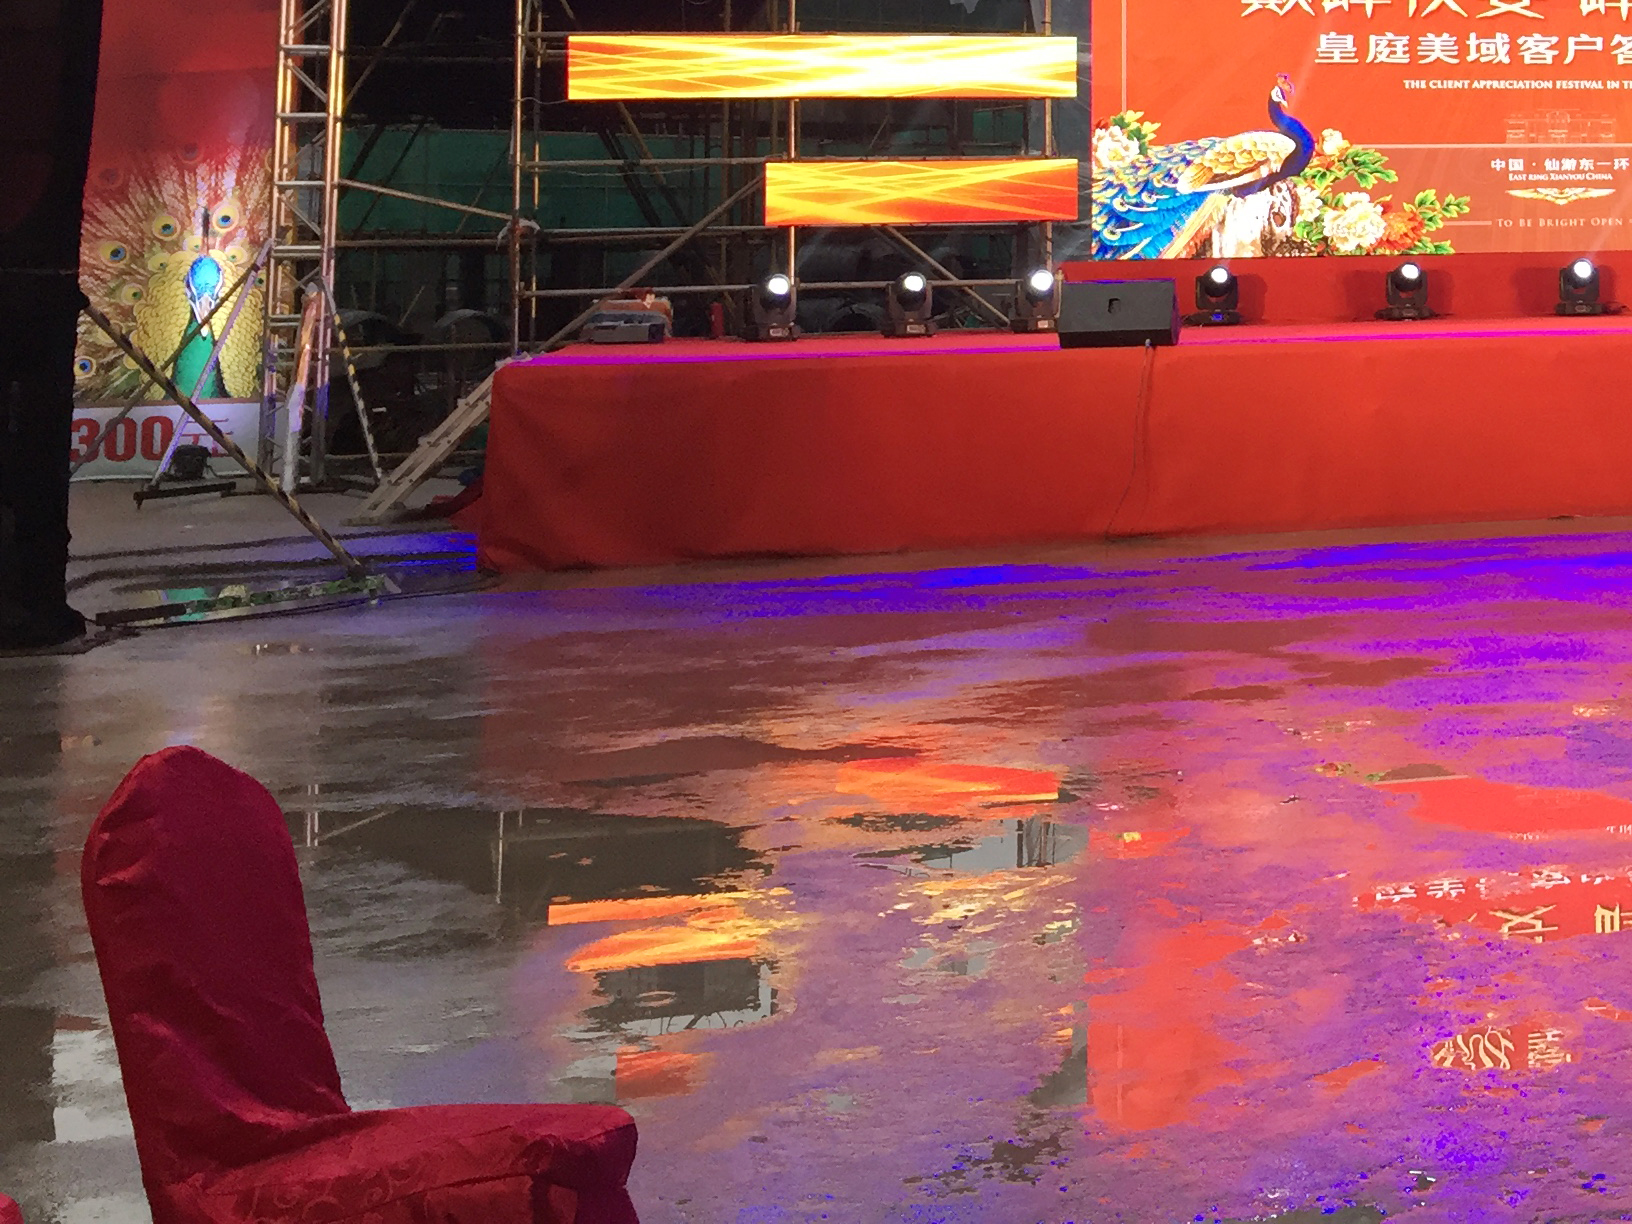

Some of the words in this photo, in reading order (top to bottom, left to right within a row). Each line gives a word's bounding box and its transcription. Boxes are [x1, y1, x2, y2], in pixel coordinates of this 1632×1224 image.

[1403, 79, 1426, 89] THE
[1429, 79, 1470, 89] CLIENT
[1472, 79, 1553, 89] APPRECIATION
[1556, 80, 1604, 90] FESTIVAL
[1607, 80, 1619, 89] IN
[1496, 218, 1513, 228] TO
[1519, 218, 1533, 228] BE
[1539, 218, 1586, 228] BRIGHT
[1591, 217, 1623, 227] OPEN
